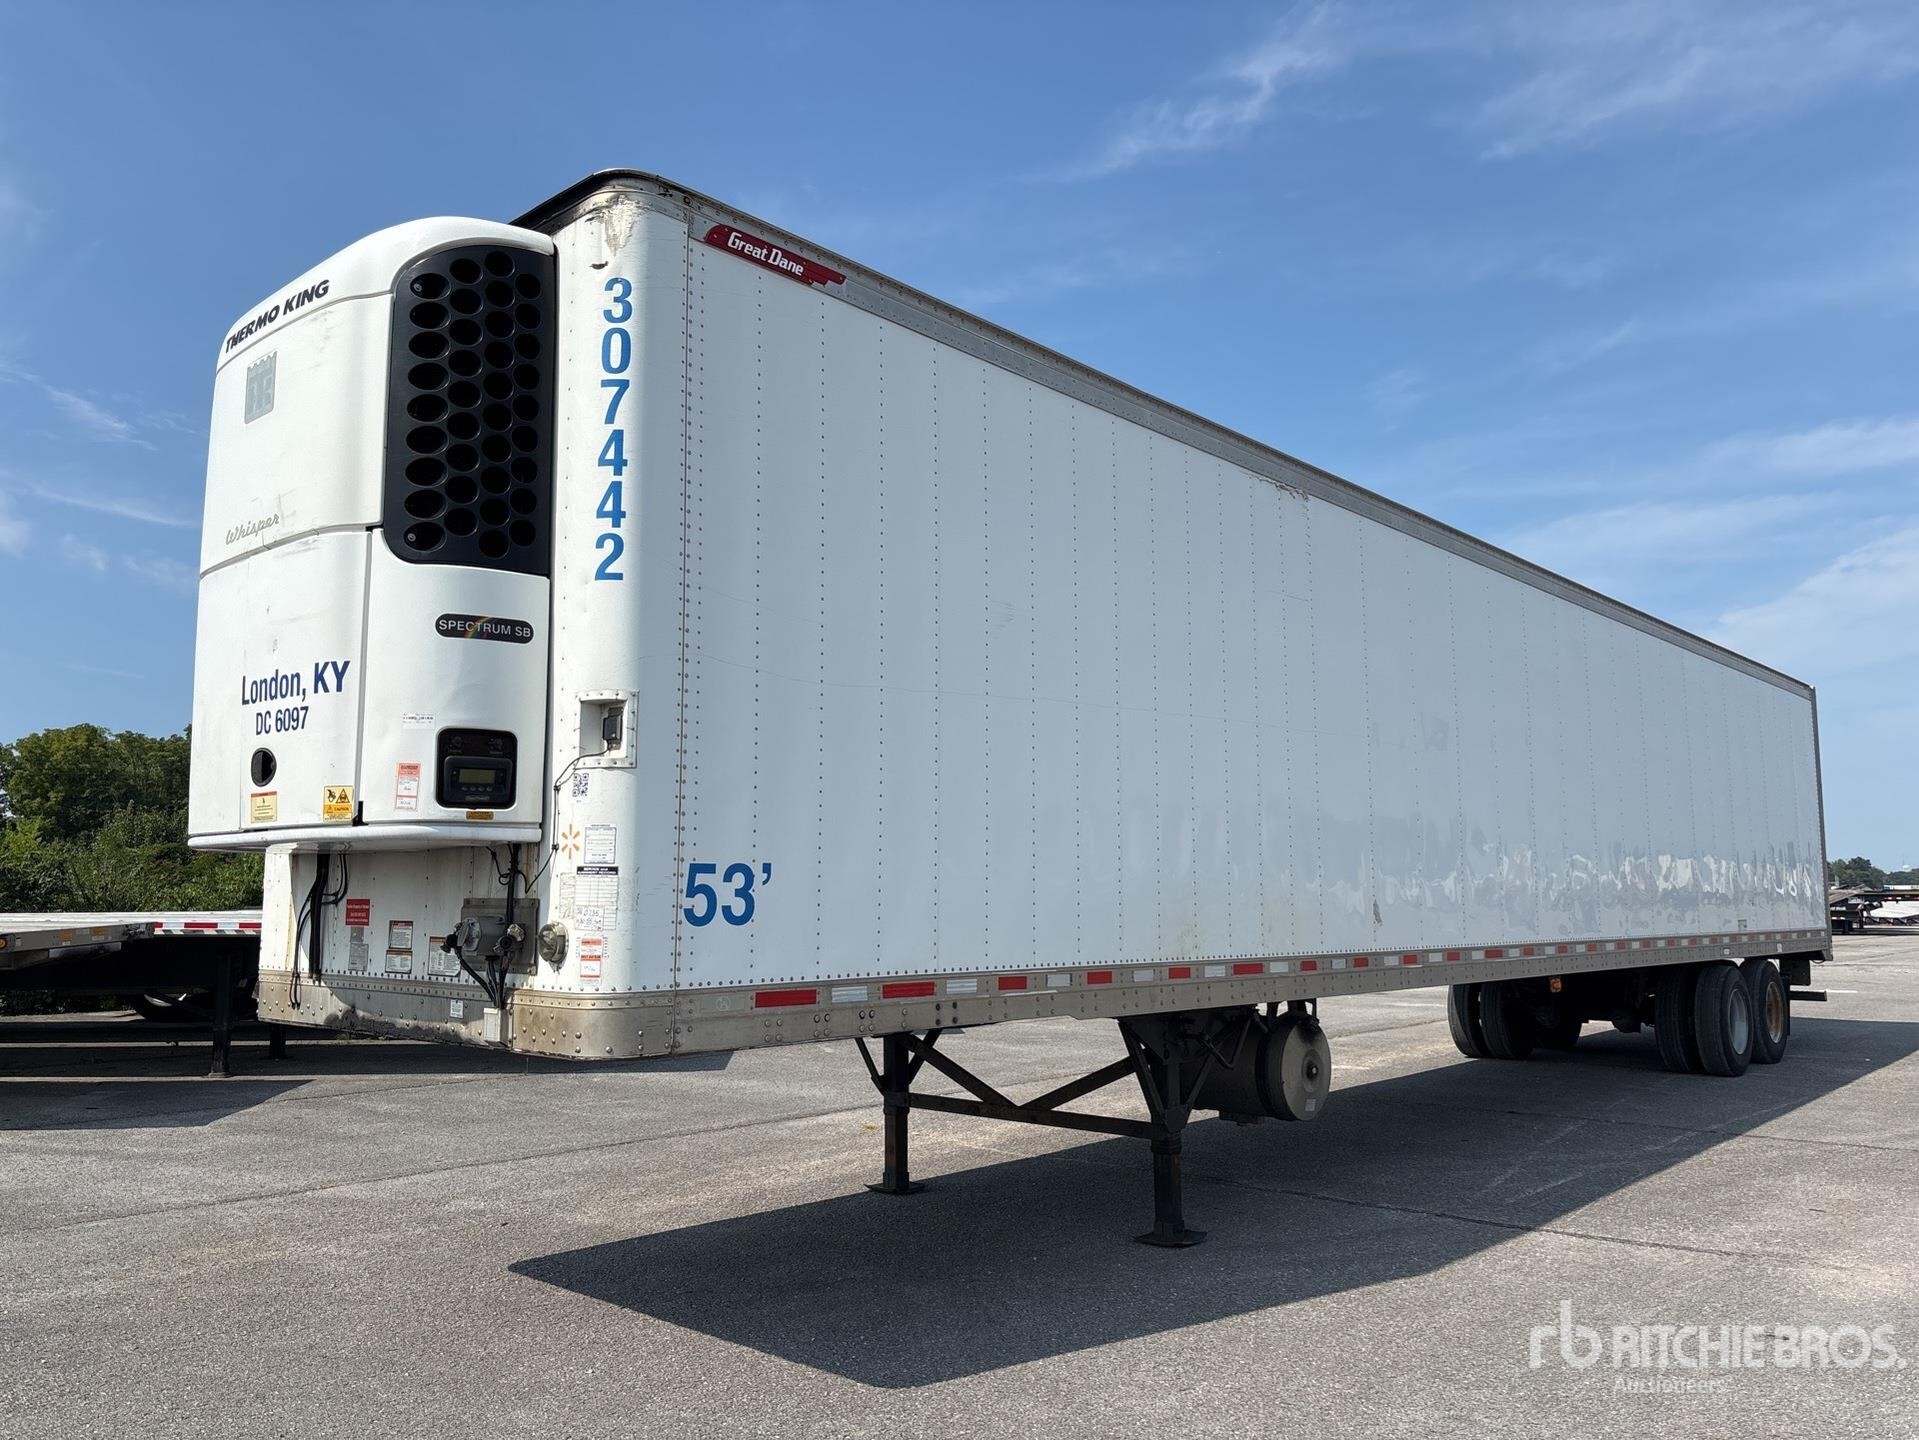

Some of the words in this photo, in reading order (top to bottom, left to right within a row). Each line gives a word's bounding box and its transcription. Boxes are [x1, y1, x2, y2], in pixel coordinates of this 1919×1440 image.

[727, 231, 769, 262] Great
[767, 248, 804, 275] Dane
[225, 304, 280, 354] THERMO
[282, 279, 330, 316] KING
[594, 277, 634, 581] 307442
[225, 513, 280, 545] Whisper
[438, 619, 511, 635] SPECTRUM
[514, 626, 532, 637] SB
[241, 668, 307, 706] London,
[313, 660, 351, 694] KY
[255, 710, 272, 736] DC
[274, 705, 309, 733] 6097
[683, 862, 773, 928] 53'
